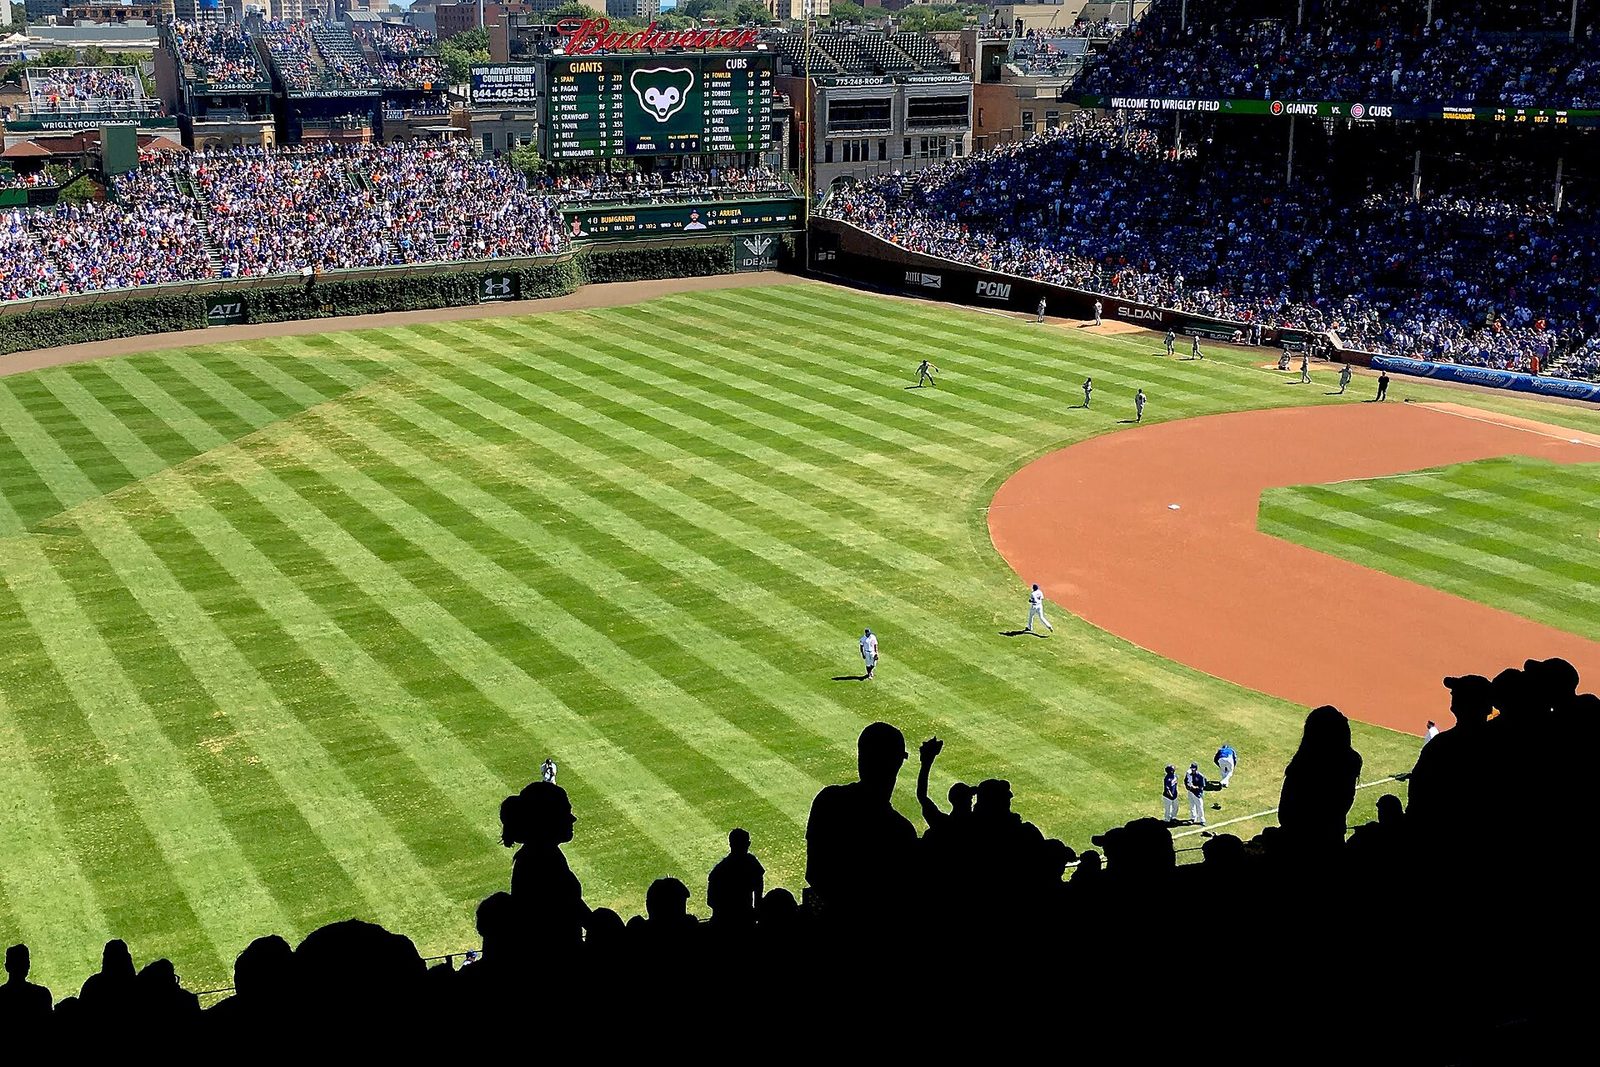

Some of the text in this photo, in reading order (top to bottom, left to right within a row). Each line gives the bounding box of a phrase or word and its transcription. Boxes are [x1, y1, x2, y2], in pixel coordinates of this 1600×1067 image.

[556, 18, 757, 54] Budweiser
[570, 62, 602, 73] GIANTS
[726, 59, 747, 69] CUBS
[473, 89, 537, 97] 844-465-351
[1111, 98, 1219, 111] WELCOME TO WRIGLEY FIELD
[1286, 104, 1318, 115] GIANTS
[1368, 106, 1392, 117] CUBS
[42, 120, 140, 129] WRIGLEYROOFCOM
[601, 215, 636, 224] BUMGARNER
[743, 257, 772, 266] IDEAL
[976, 280, 1011, 298] PCM
[208, 303, 241, 315] ATI
[1118, 307, 1162, 321] SLOAN
[1454, 369, 1506, 382] Reynolds Wrap
